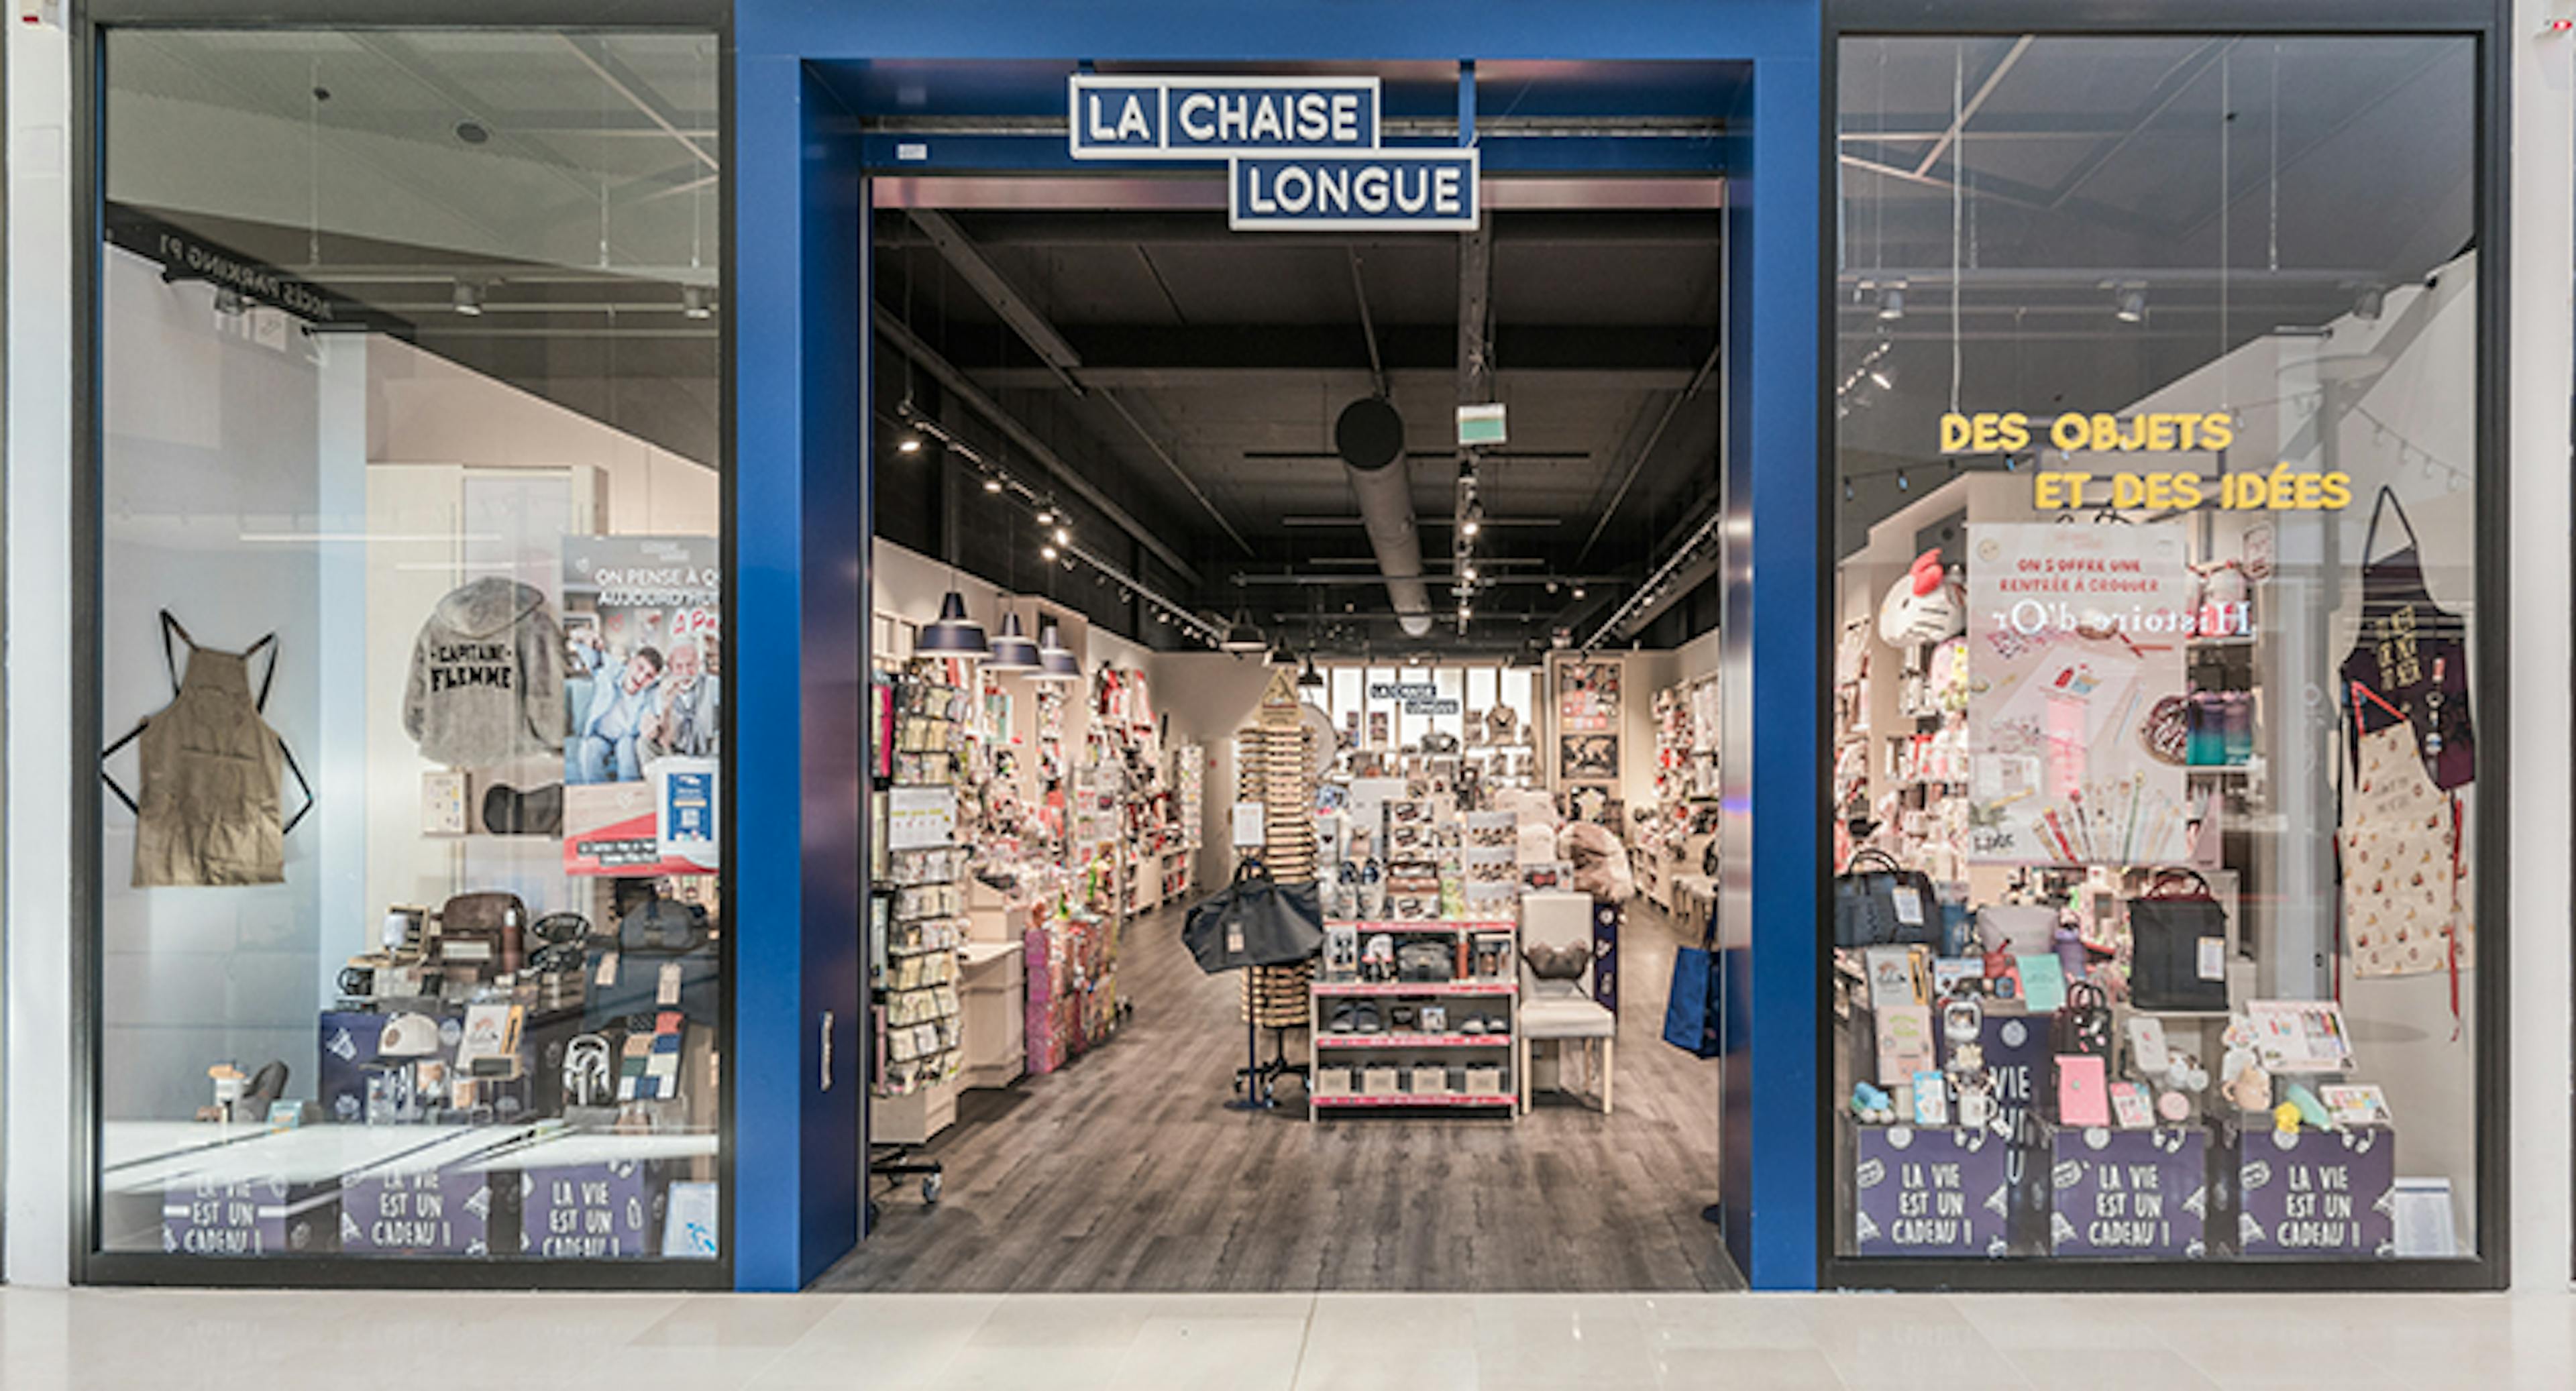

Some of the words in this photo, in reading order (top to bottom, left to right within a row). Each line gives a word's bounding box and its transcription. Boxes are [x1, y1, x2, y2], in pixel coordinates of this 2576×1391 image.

[1089, 95, 1150, 141] LA
[1179, 94, 1358, 141] CHAISE
[1250, 166, 1461, 213] LONGUE
[1941, 412, 2030, 452] DES
[2051, 412, 2233, 452] OBJETS
[2035, 472, 2092, 510] ET
[2112, 472, 2202, 510] DES
[2221, 462, 2352, 510] IDÉES
[594, 569, 623, 586] ON
[2017, 559, 2041, 573] ON
[1900, 1163, 1925, 1189] LA
[1930, 1163, 1961, 1189] VIE
[2098, 1164, 2122, 1190] LA
[2129, 1165, 2159, 1190] VIE
[2288, 1165, 2312, 1191] LA
[2319, 1166, 2349, 1190] VIE
[380, 1192, 410, 1218] EST
[416, 1193, 442, 1218] UN
[551, 1180, 575, 1207] LA
[581, 1180, 610, 1205] VIE
[1898, 1191, 1929, 1217] EST
[1937, 1192, 1966, 1217] UN
[2096, 1192, 2127, 1218] EST
[2135, 1193, 2163, 1218] UN
[2286, 1193, 2317, 1218] EST
[2324, 1194, 2353, 1219] UN
[192, 1201, 219, 1227] EST
[228, 1203, 255, 1227] UN
[549, 1208, 578, 1233] EST
[584, 1209, 614, 1234] UN
[183, 1227, 249, 1254] CADEAU
[371, 1221, 435, 1247] CADEAU
[1891, 1219, 1958, 1245] CADEAU
[2088, 1221, 2156, 1247] CADEAU
[2277, 1221, 2345, 1247] CADEAU
